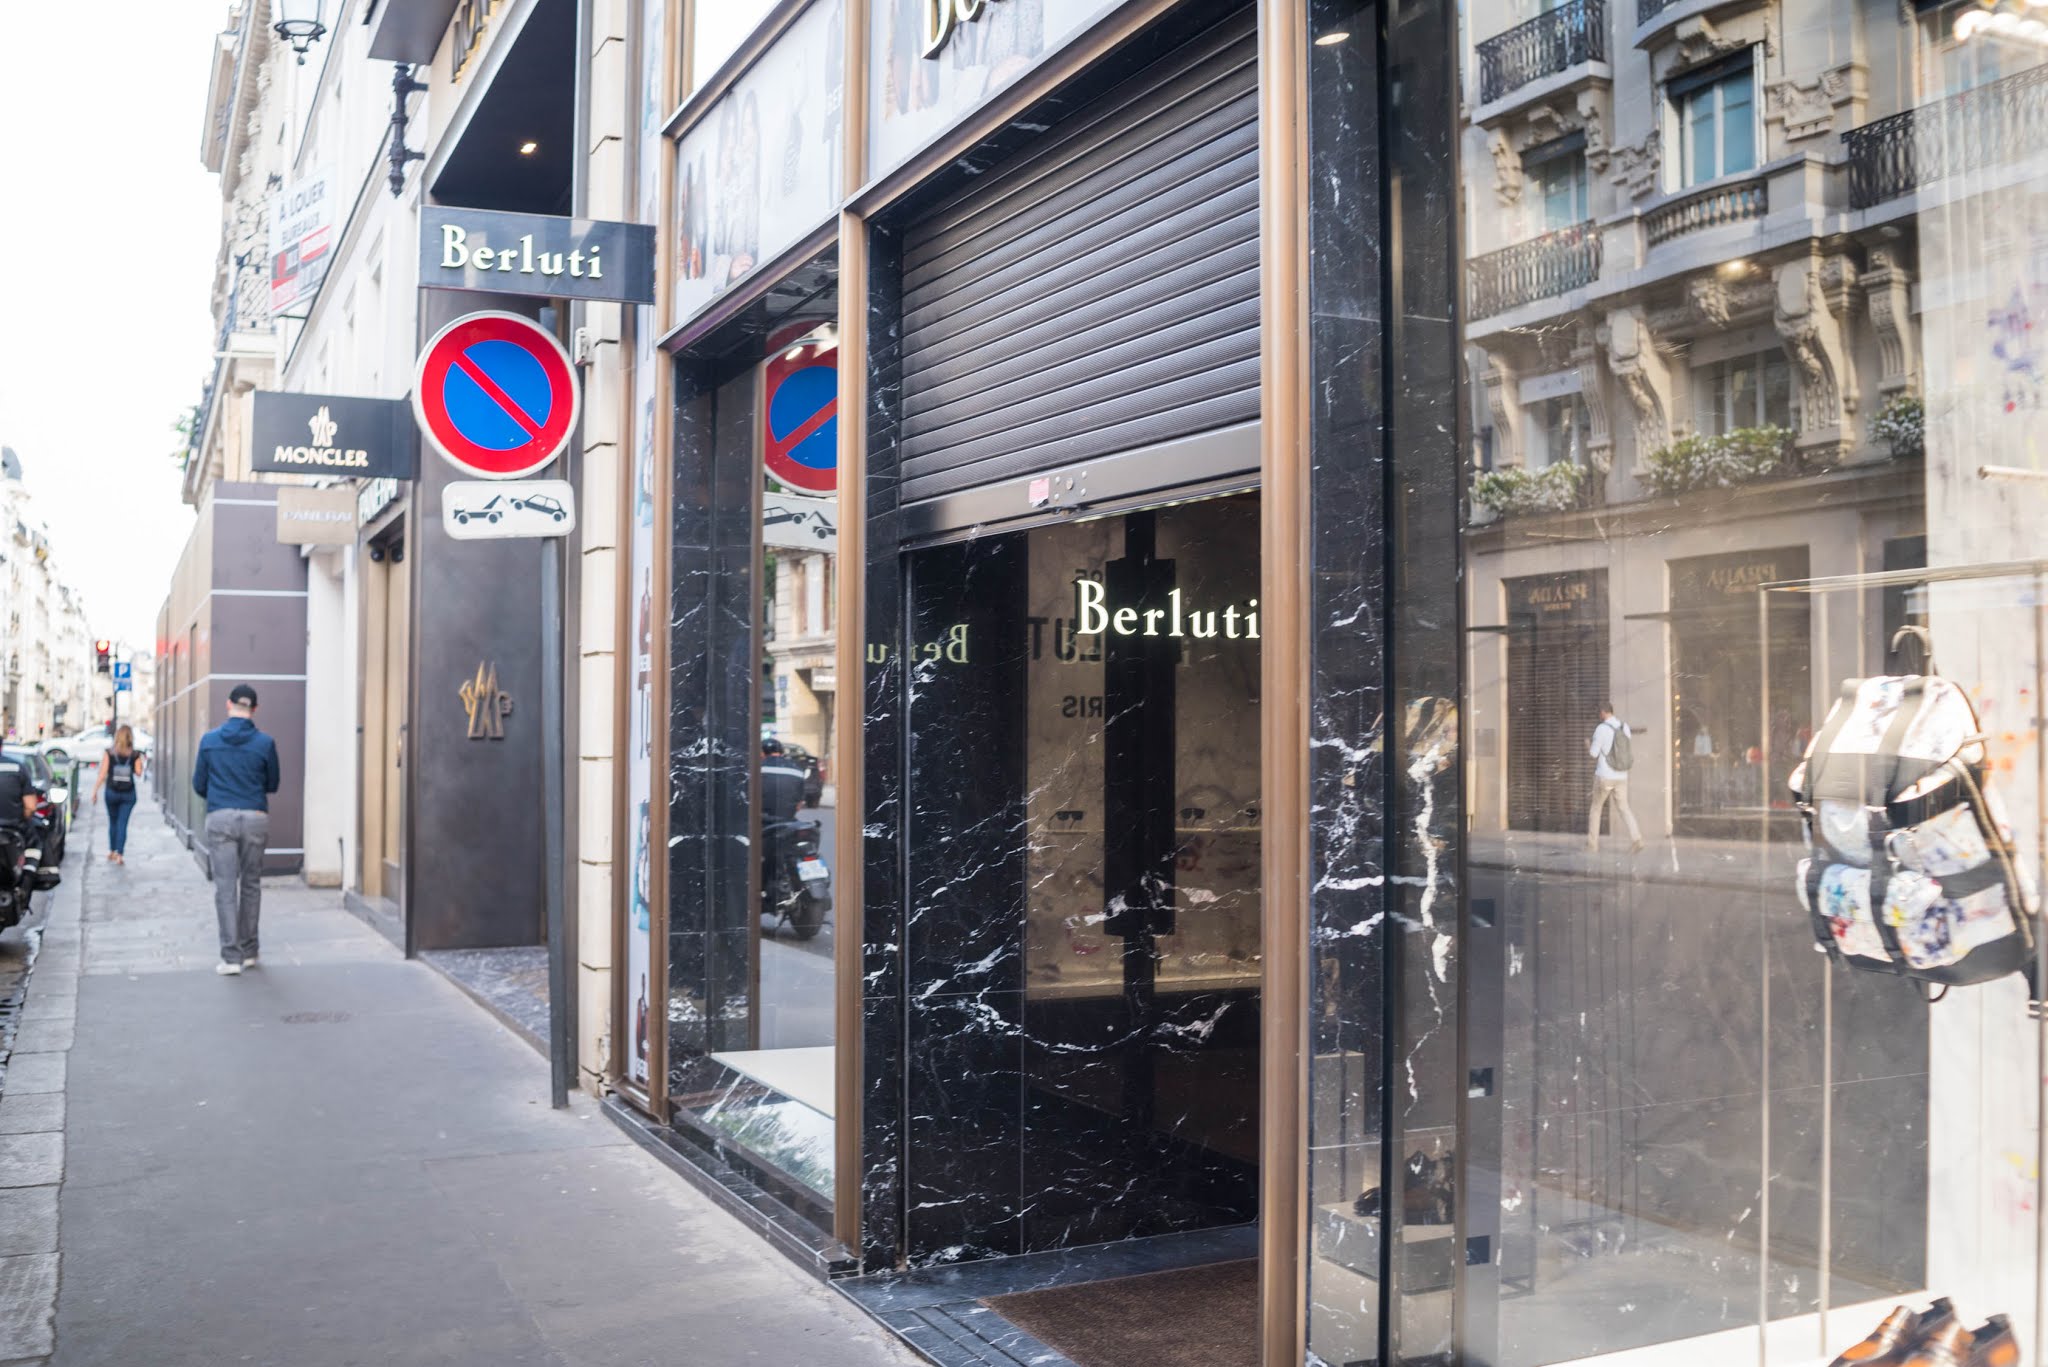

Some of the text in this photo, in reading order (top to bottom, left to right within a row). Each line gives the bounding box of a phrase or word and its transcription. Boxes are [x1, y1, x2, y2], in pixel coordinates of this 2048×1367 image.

[440, 224, 603, 279] Berluti
[274, 446, 369, 467] MONCLER
[1077, 579, 1260, 639] Berluti
